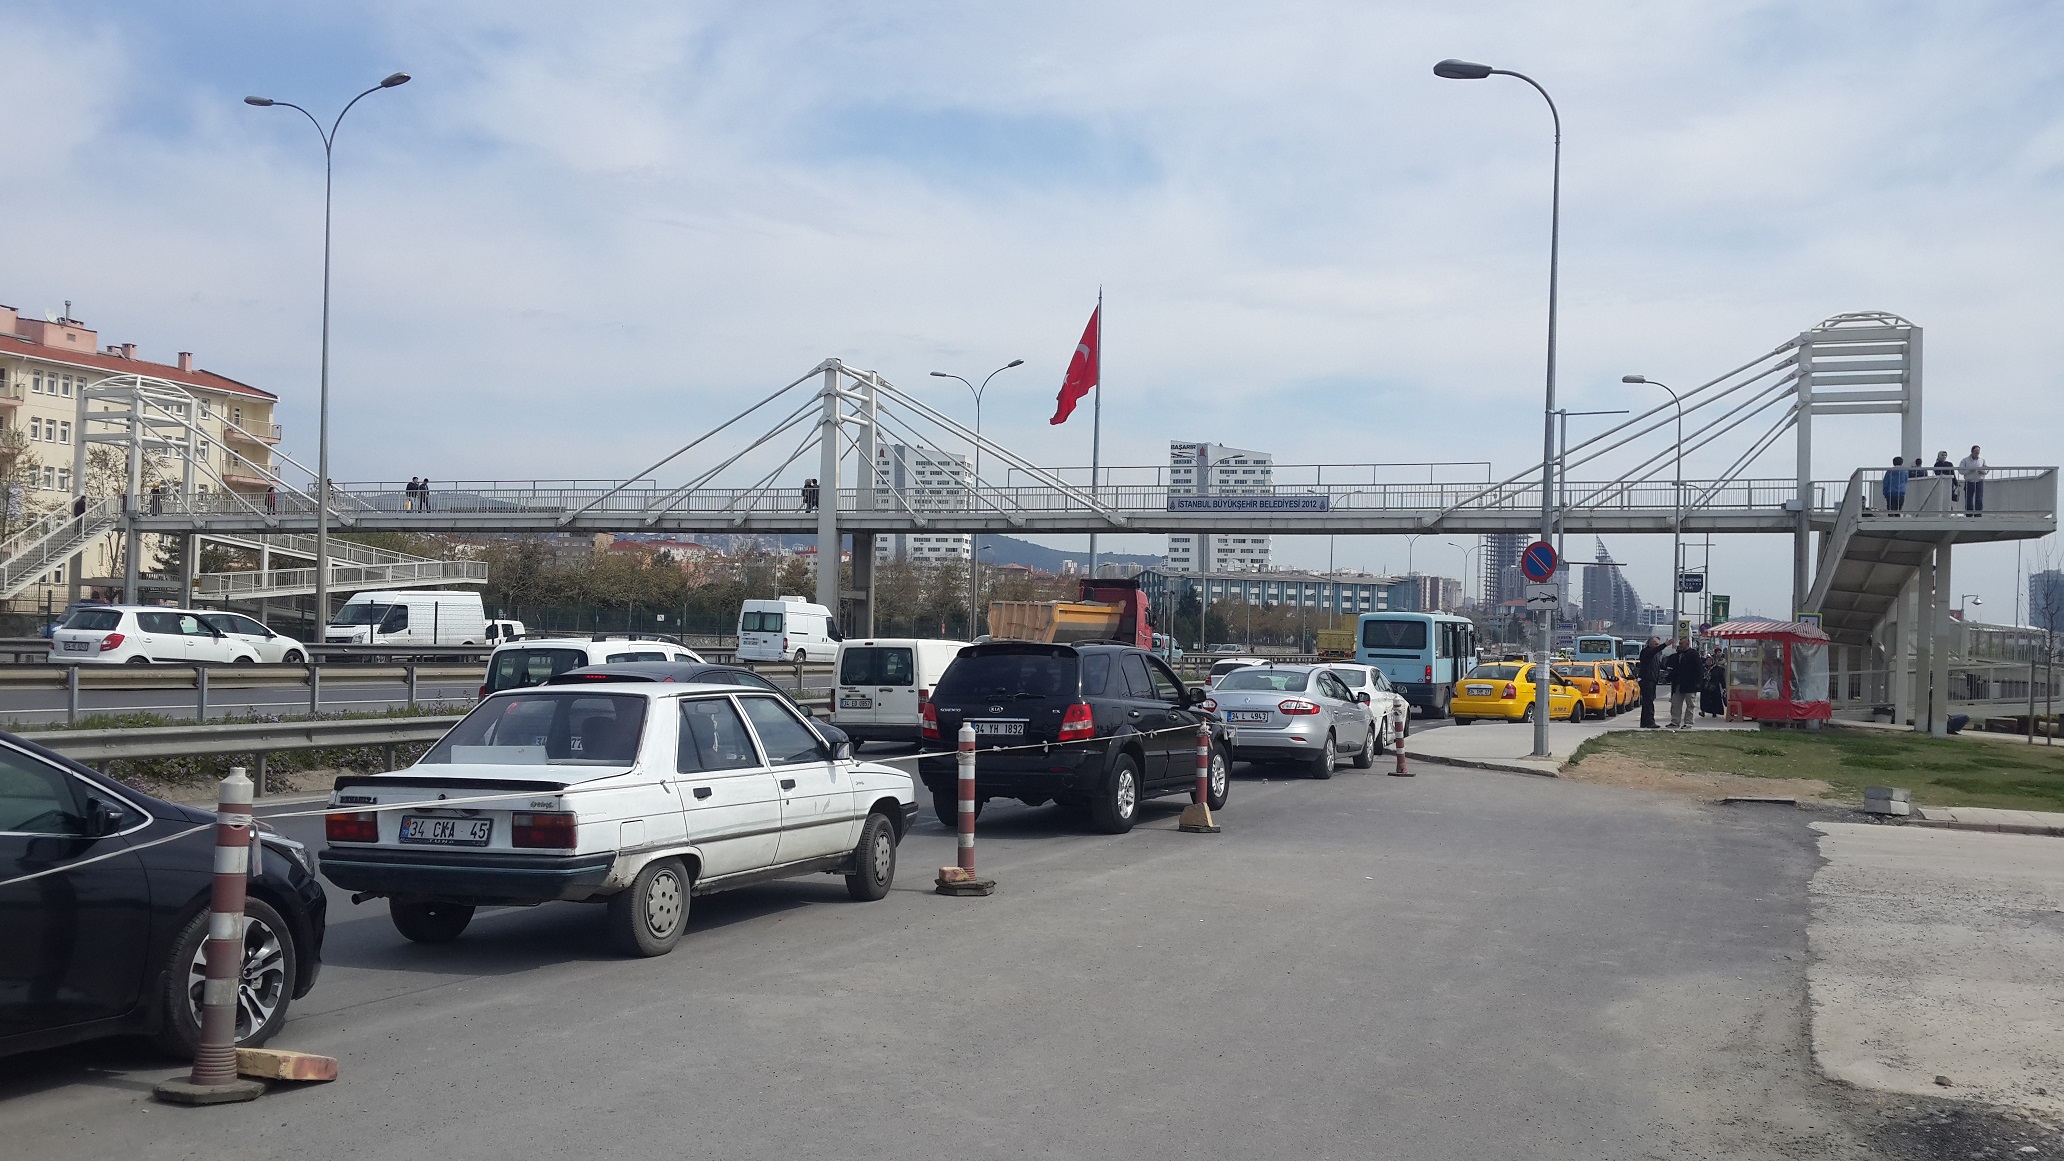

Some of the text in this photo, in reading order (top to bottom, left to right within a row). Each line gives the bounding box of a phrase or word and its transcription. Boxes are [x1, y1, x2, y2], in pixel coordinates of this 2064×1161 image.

[1177, 498, 1317, 510] İSTANBUL BÜYÜKŞEHİR BELEDİYESİ 2012
[1231, 712, 1239, 720] 34
[1241, 712, 1246, 720] L
[975, 724, 1023, 734] 34 YH 1892
[410, 821, 488, 839] 34 CKA 45
